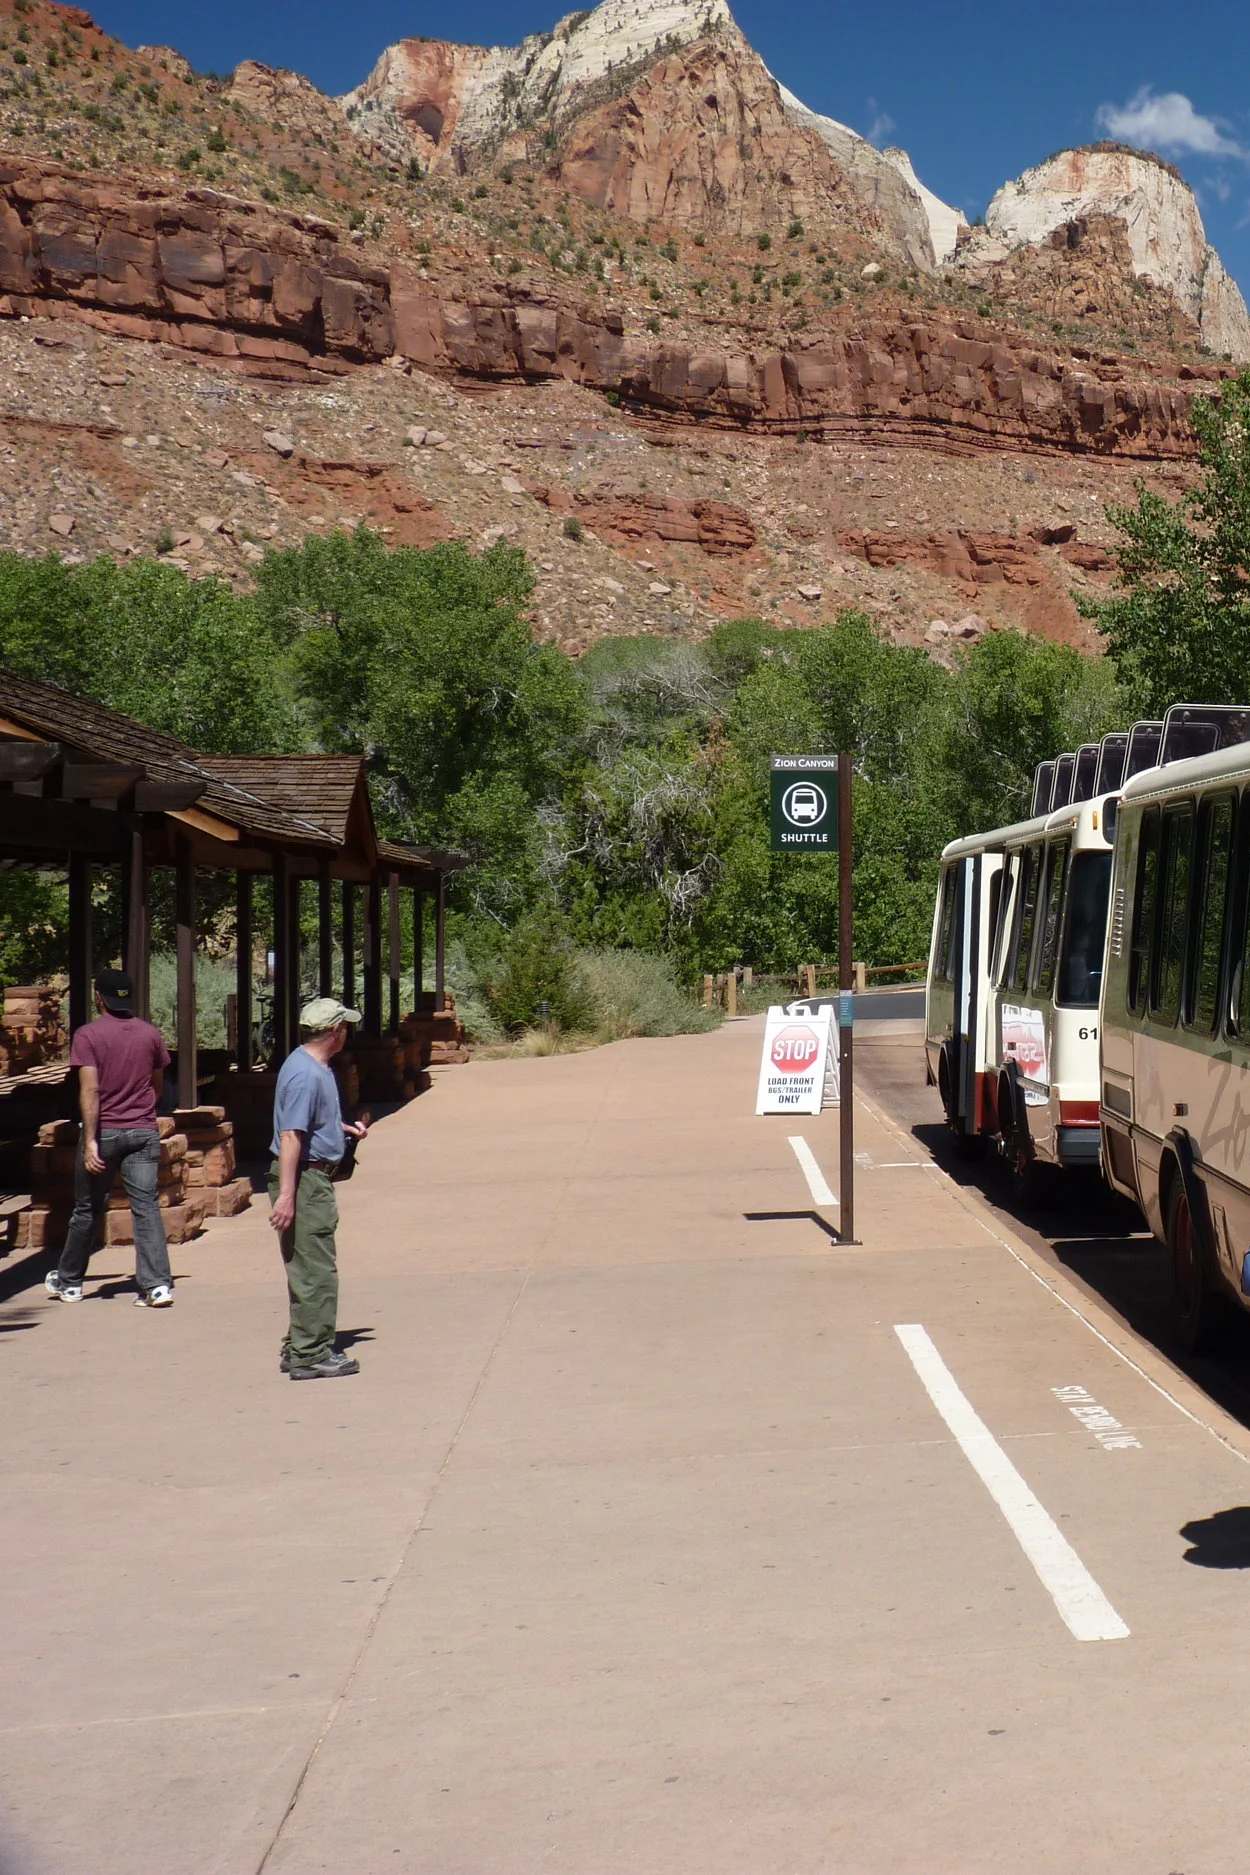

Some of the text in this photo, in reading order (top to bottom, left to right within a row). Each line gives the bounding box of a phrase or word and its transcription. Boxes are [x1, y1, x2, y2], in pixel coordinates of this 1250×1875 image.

[774, 759, 834, 767] ZION CANYON
[781, 833, 828, 843] SHUTTLE
[1079, 1027, 1098, 1040] 61
[773, 1039, 817, 1061] STOP
[767, 1077, 815, 1085] LOAD FRONT
[778, 1094, 800, 1103] ONLY
[1050, 1385, 1097, 1403] STAY
